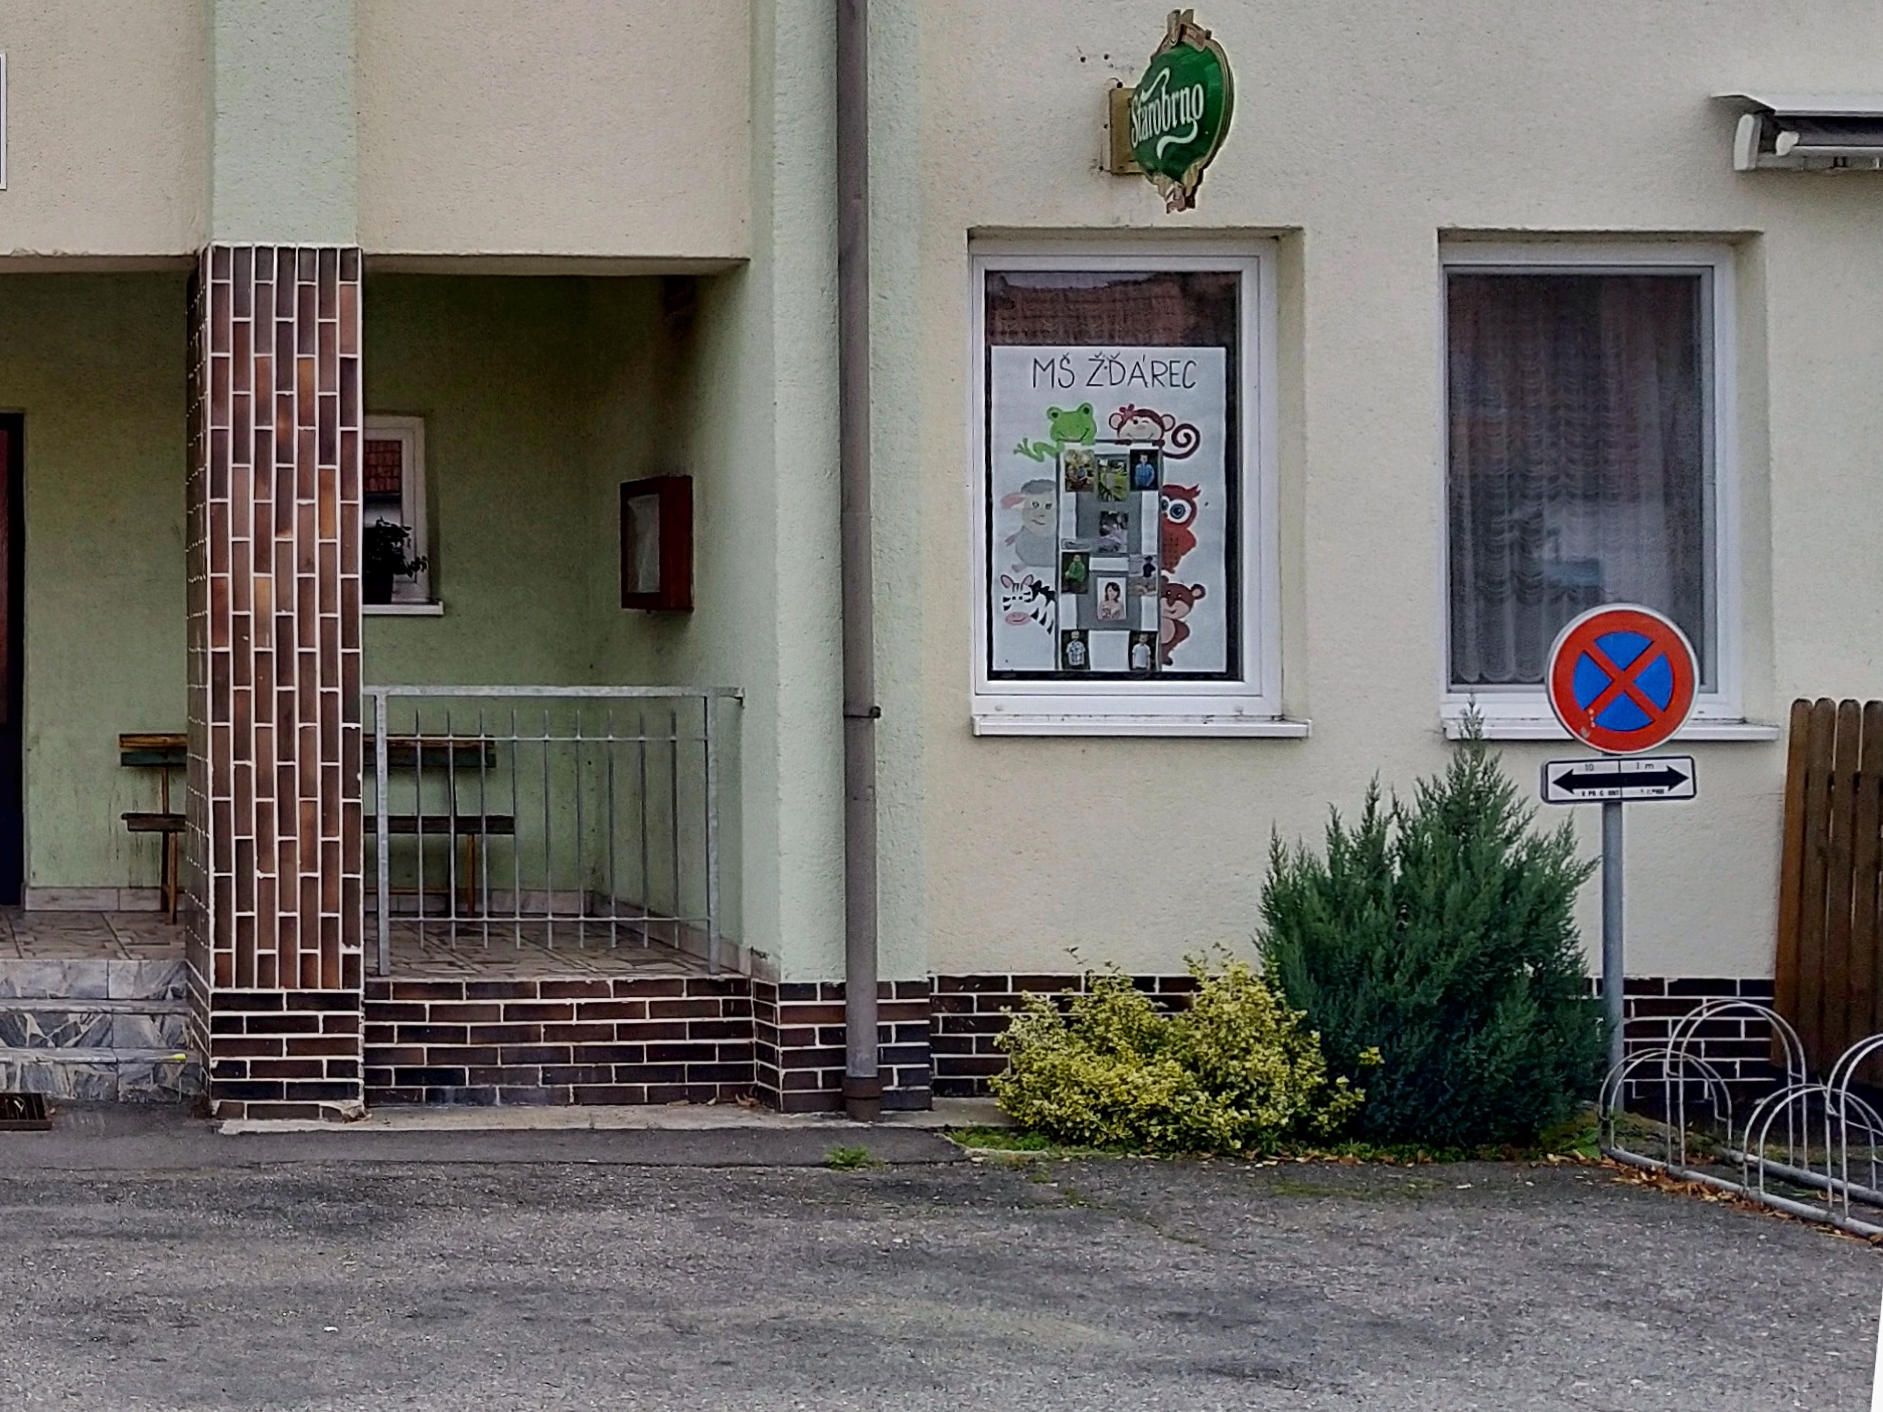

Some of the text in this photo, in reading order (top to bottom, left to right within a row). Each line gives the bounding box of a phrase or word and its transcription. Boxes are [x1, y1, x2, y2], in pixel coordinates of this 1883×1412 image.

[1130, 68, 1205, 150] Starobrno
[1032, 351, 1197, 389] MŠ ŽĎÁREC
